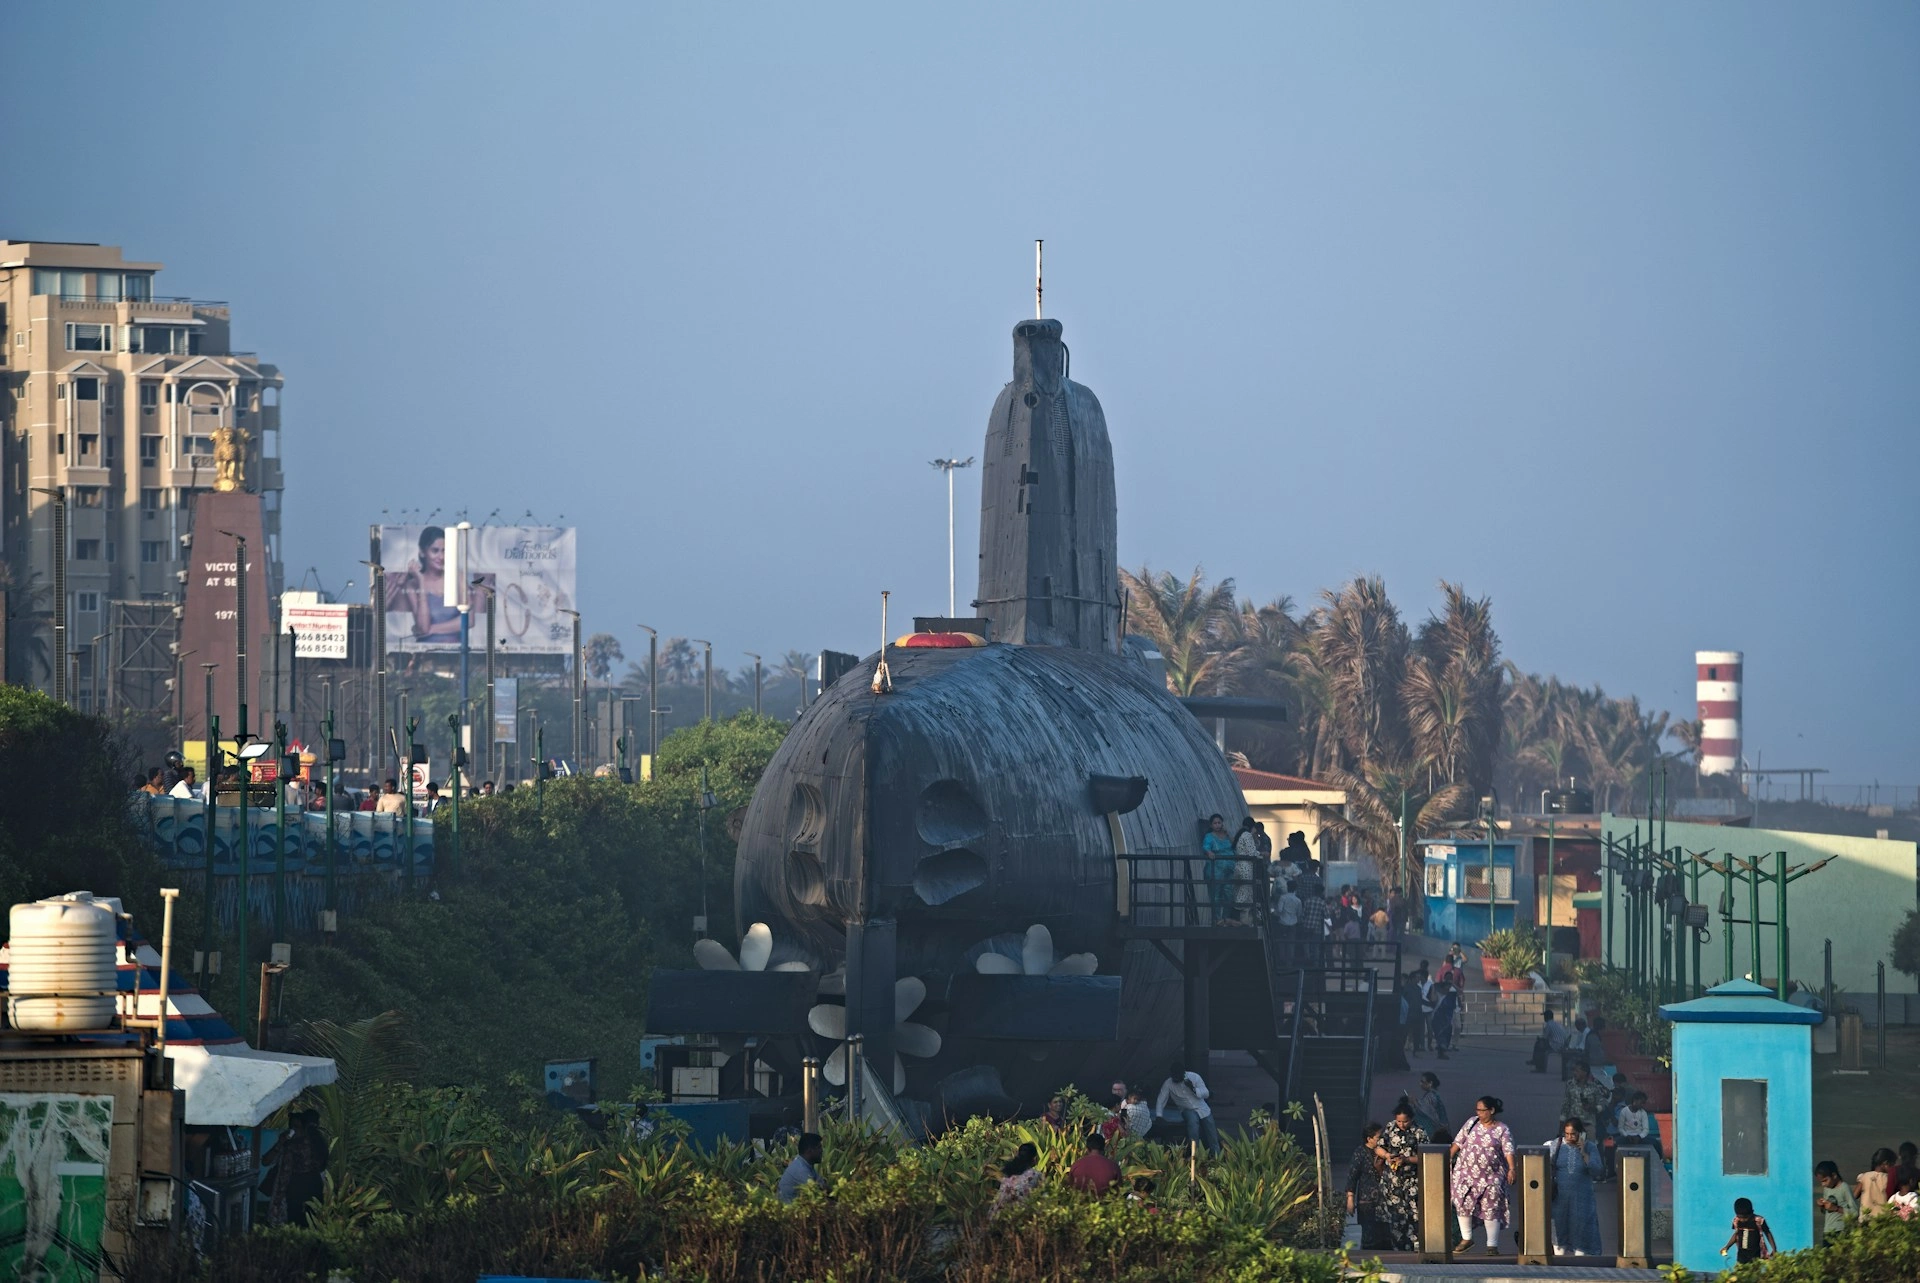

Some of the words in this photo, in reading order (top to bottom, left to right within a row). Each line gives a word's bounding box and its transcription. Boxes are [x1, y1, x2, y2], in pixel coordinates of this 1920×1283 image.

[504, 548, 557, 559] Diamonds
[205, 562, 252, 572] VICTOY
[206, 577, 220, 587] AT
[224, 577, 237, 587] SE
[315, 633, 345, 642] 85423
